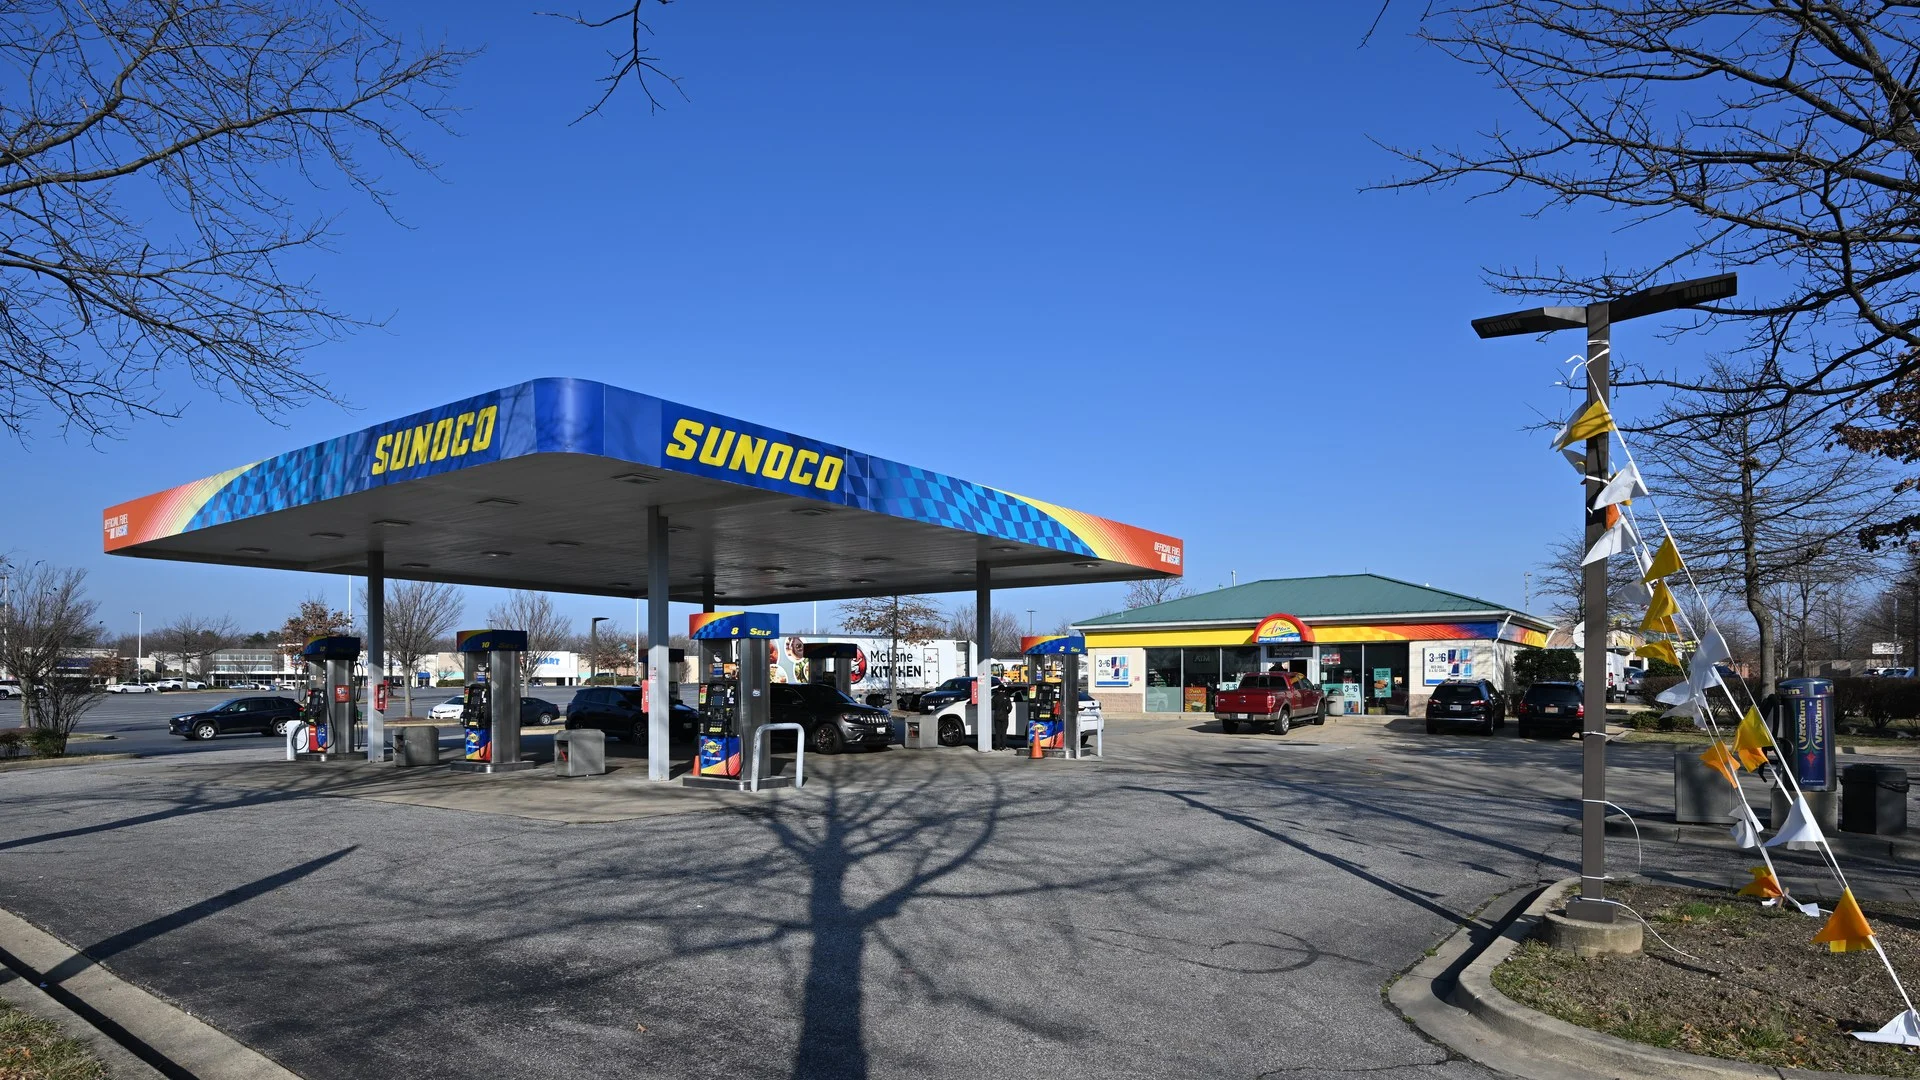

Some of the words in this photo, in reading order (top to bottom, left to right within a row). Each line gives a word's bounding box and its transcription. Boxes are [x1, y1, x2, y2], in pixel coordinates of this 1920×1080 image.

[371, 405, 498, 475] SUNOCO
[665, 418, 844, 491] SUNOCO
[1171, 545, 1181, 557] FUEL
[730, 626, 739, 635] 8
[481, 641, 490, 649] 10
[870, 650, 913, 662] McLane
[1429, 652, 1435, 663] 3
[1098, 659, 1103, 668] 3
[1344, 684, 1350, 693] 3
